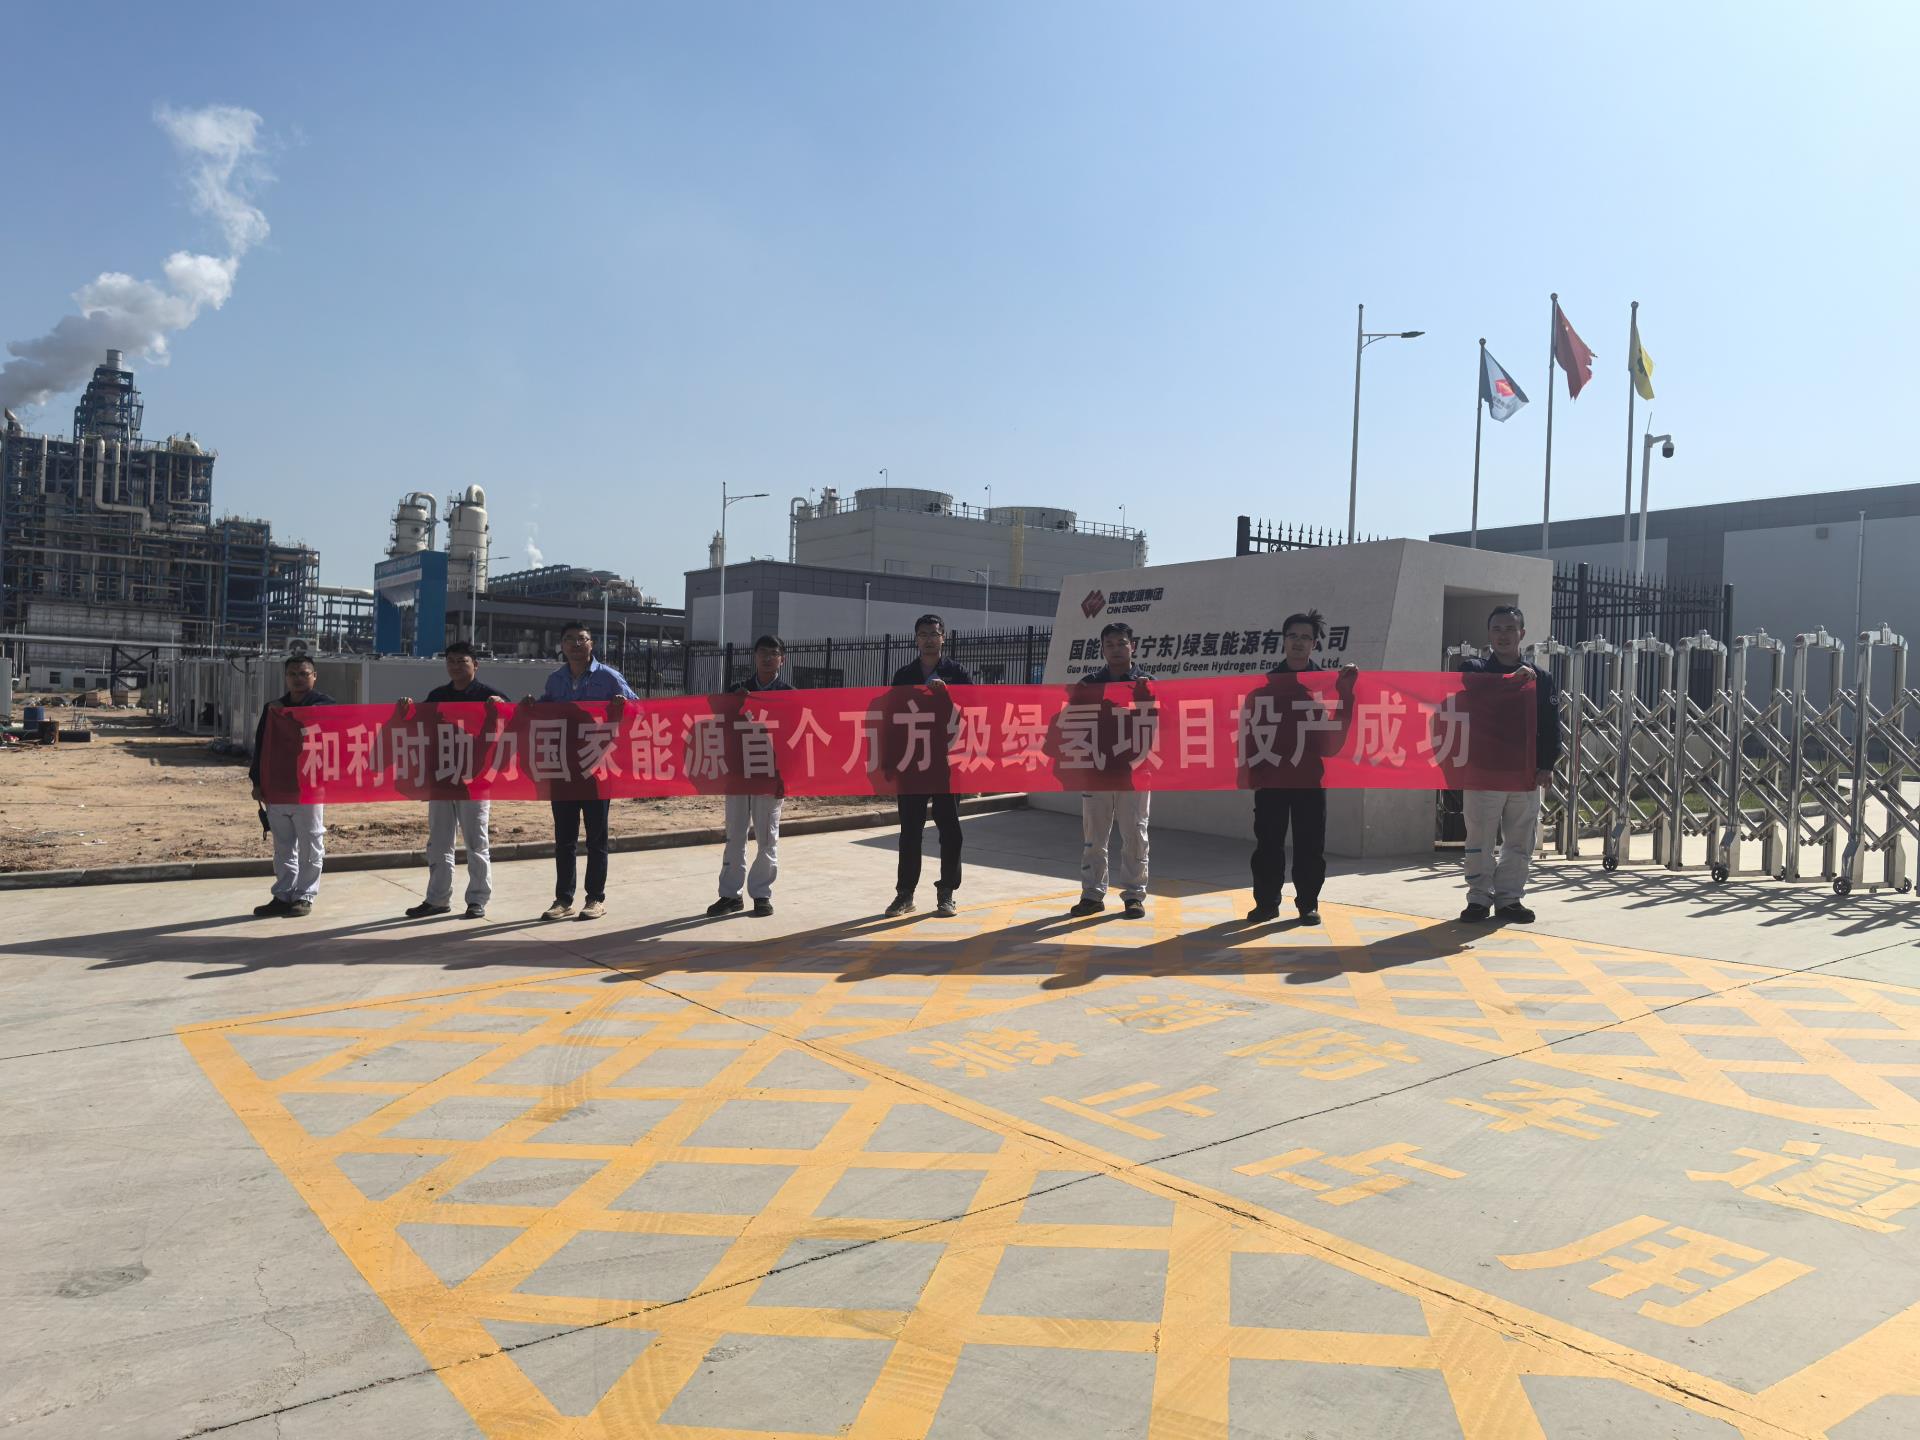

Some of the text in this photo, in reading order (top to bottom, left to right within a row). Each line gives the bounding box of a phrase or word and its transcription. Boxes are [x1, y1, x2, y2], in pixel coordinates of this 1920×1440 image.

[1108, 587, 1164, 604] 国家能源集团
[1122, 604, 1151, 613] ENERGY
[1066, 665, 1081, 674] Guo
[1183, 661, 1209, 672] Green
[1211, 660, 1257, 673] Hydrogen
[1321, 657, 1342, 668] Ltd.
[300, 690, 1470, 788] 和利时助力国家能源首个万方级绿氢项目投产成功
[905, 1026, 1817, 1328] 禁止占用
